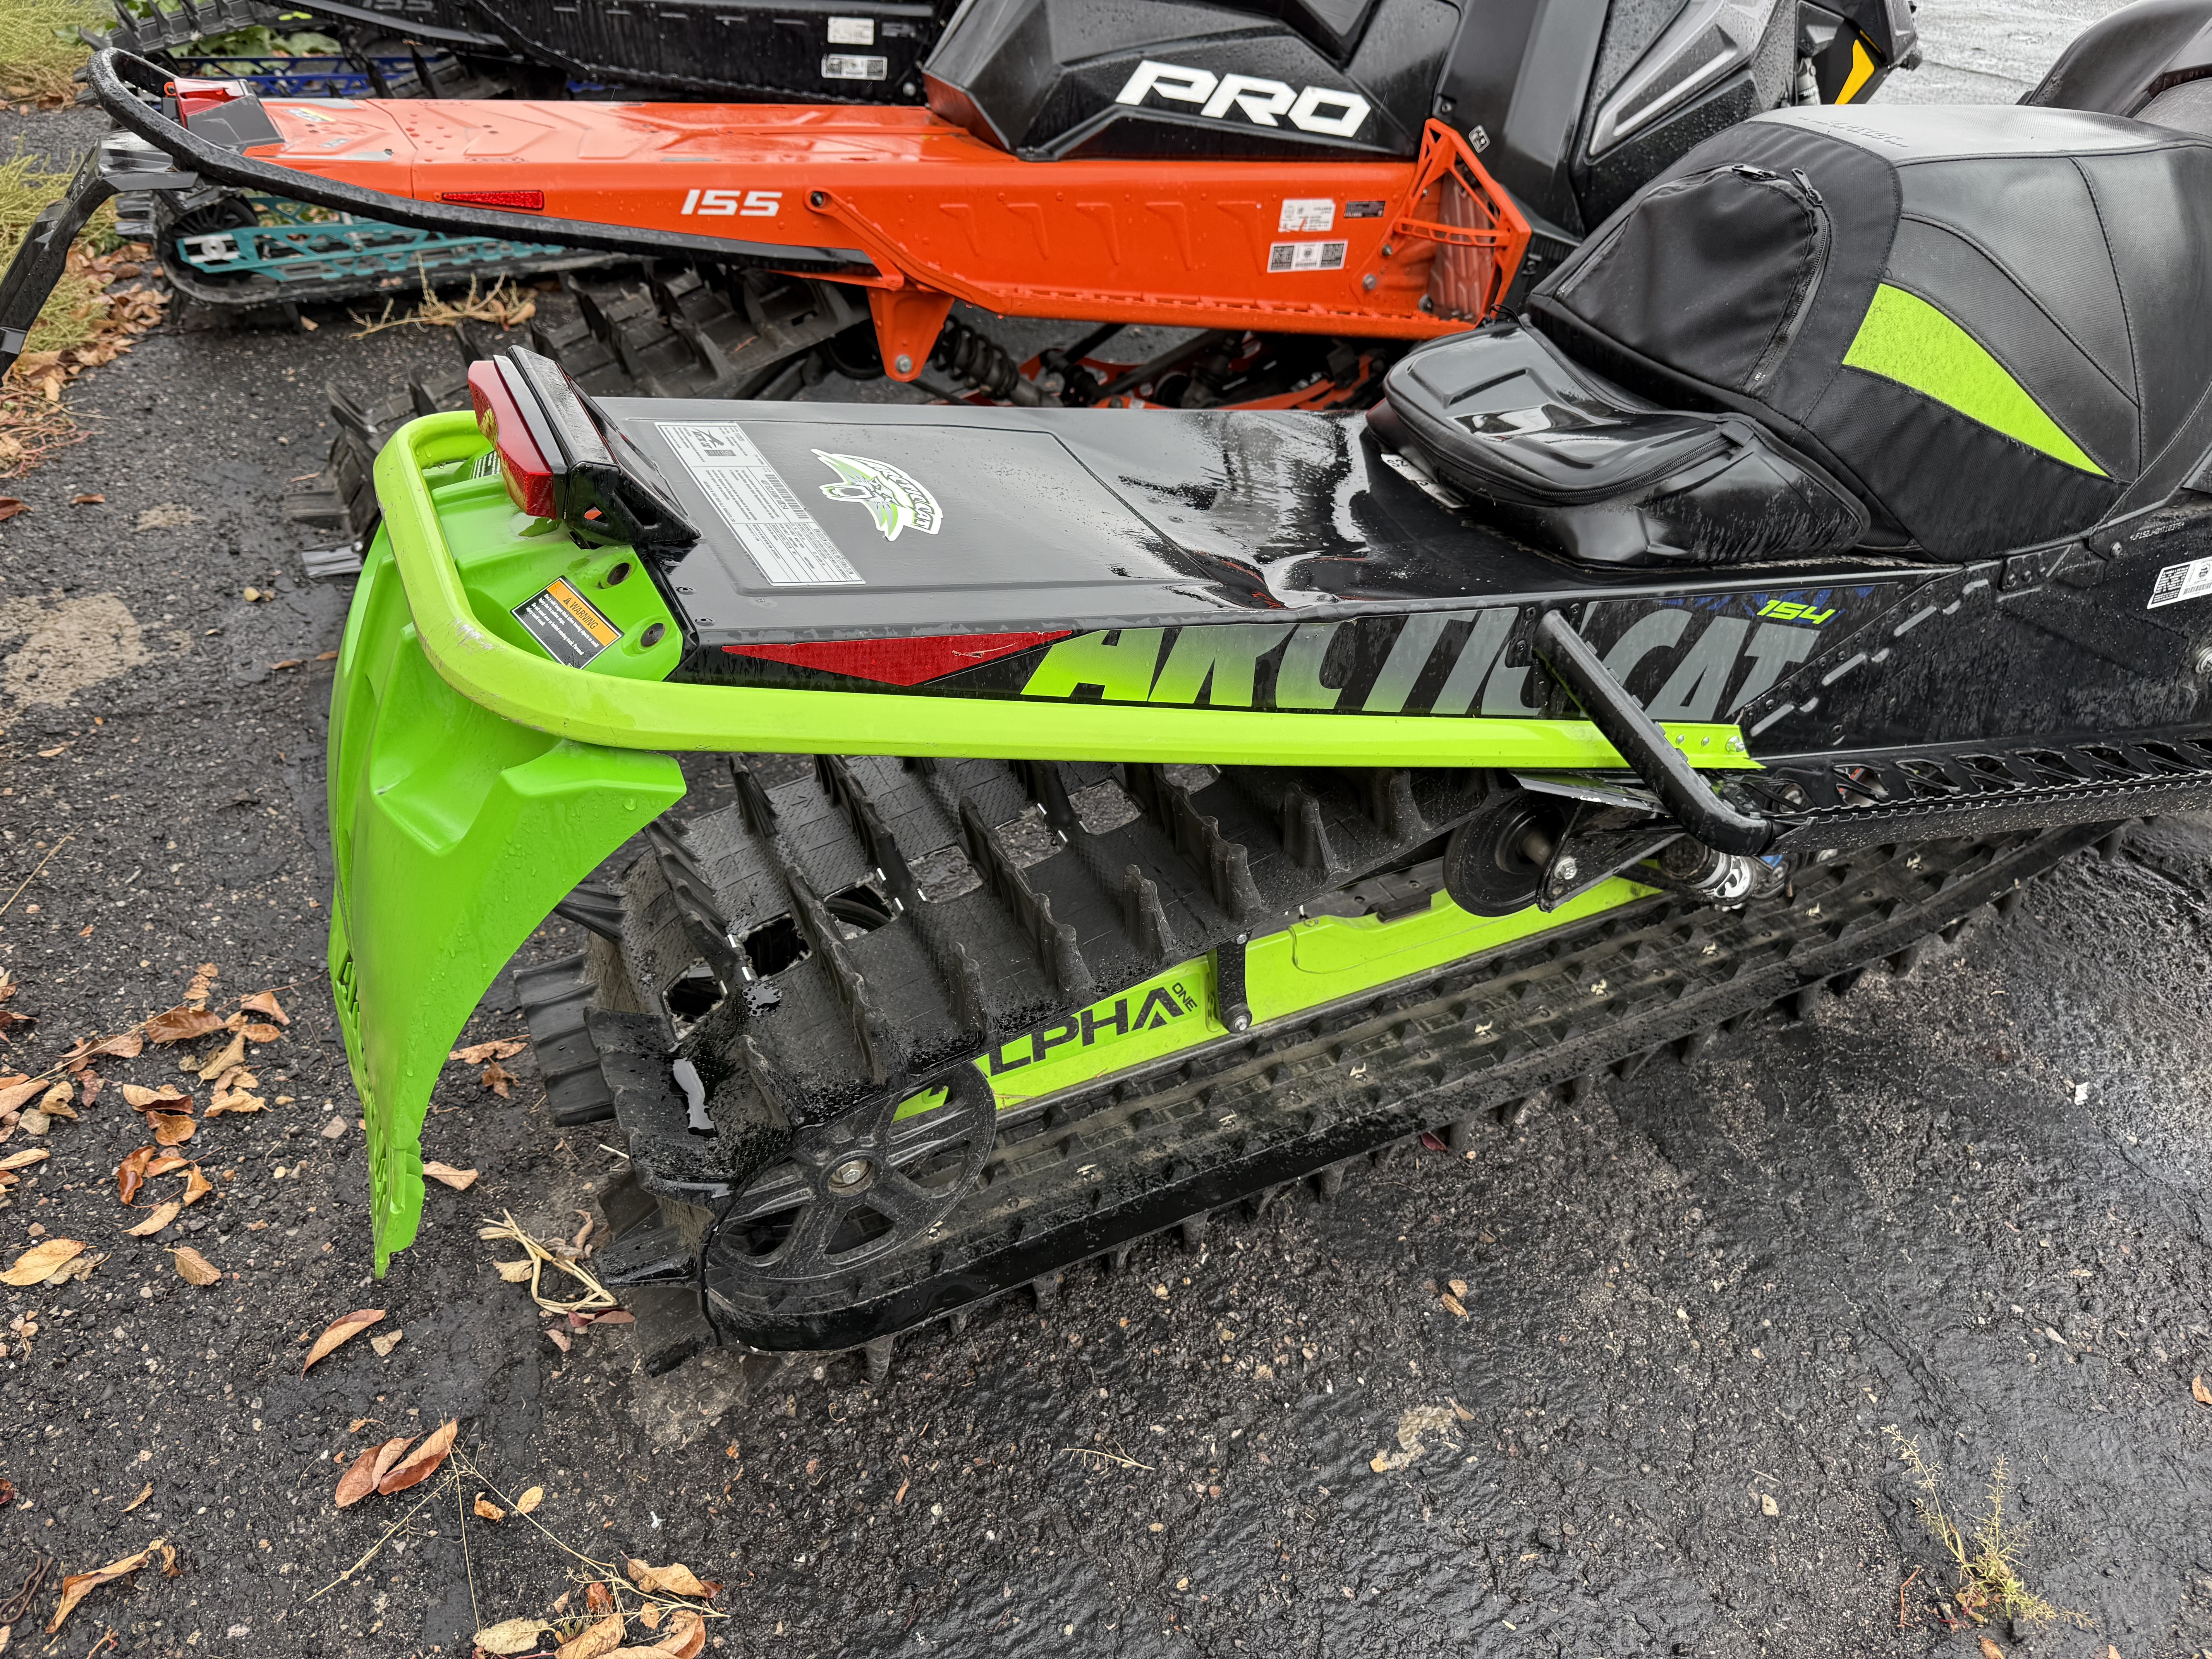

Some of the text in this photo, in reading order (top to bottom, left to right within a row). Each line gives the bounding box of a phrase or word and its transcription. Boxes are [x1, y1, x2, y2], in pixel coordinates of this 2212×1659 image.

[1116, 60, 1371, 137] PRO
[681, 189, 782, 216] 155
[568, 601, 599, 629] WARNING
[1757, 599, 1836, 625] 154
[550, 622, 561, 631] behind
[572, 644, 584, 655] Personal
[580, 630, 590, 639] objects
[1599, 608, 1821, 721] CAT
[983, 982, 1198, 1078] LPHA ONE
